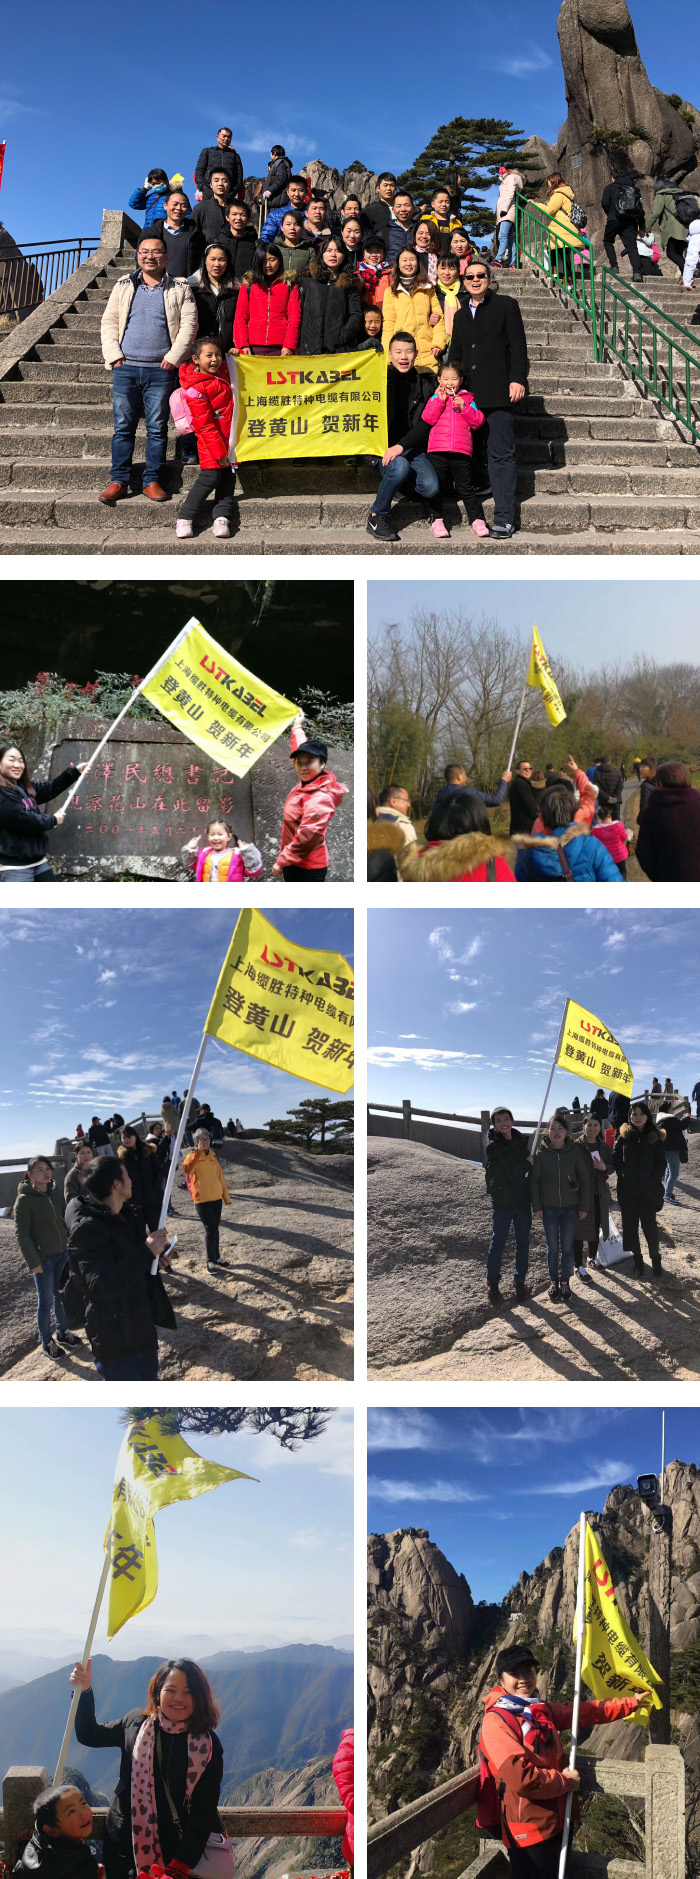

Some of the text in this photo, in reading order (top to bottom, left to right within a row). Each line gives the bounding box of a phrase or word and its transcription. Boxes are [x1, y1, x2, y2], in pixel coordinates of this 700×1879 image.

[266, 368, 361, 385] LSTKABEL
[245, 391, 381, 407] 上海缆胜特种电缆有限公司
[247, 413, 379, 438] 登黄山 贺新年
[174, 659, 271, 743] 上海缆胜特种电缆有限公司
[200, 654, 267, 718] LSTKABEL
[160, 675, 255, 759] 登黄山 贺新年
[69, 761, 234, 785] 澤民總書記
[223, 985, 296, 1039] 登黄山
[580, 1019, 619, 1047] LSTKA
[564, 1043, 631, 1084] 登黄山 贺新年
